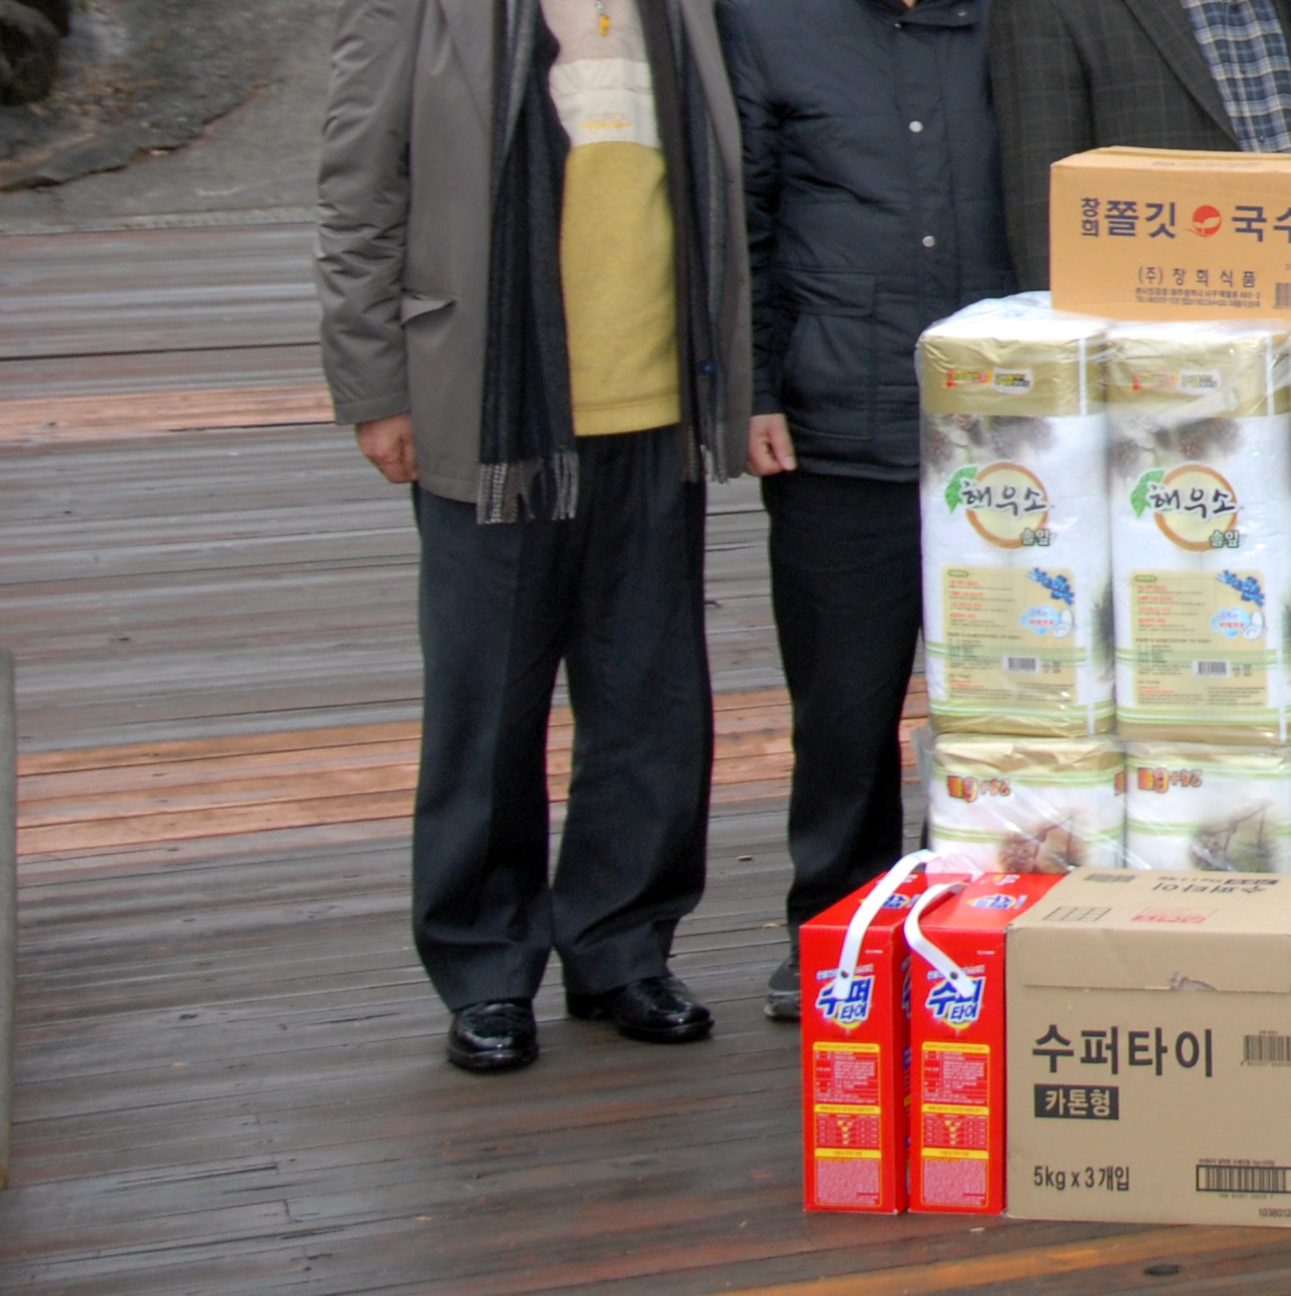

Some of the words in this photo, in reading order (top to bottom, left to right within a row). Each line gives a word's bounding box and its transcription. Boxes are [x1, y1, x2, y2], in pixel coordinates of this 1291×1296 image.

[1104, 199, 1177, 242] 쫄깃
[1138, 265, 1164, 285] (주)
[962, 480, 1047, 516] 해우소
[1150, 483, 1237, 519] 해우소
[1032, 1023, 1213, 1077] 수퍼타이
[1044, 1087, 1113, 1117] 카톤형
[1034, 1164, 1066, 1193] 5kg
